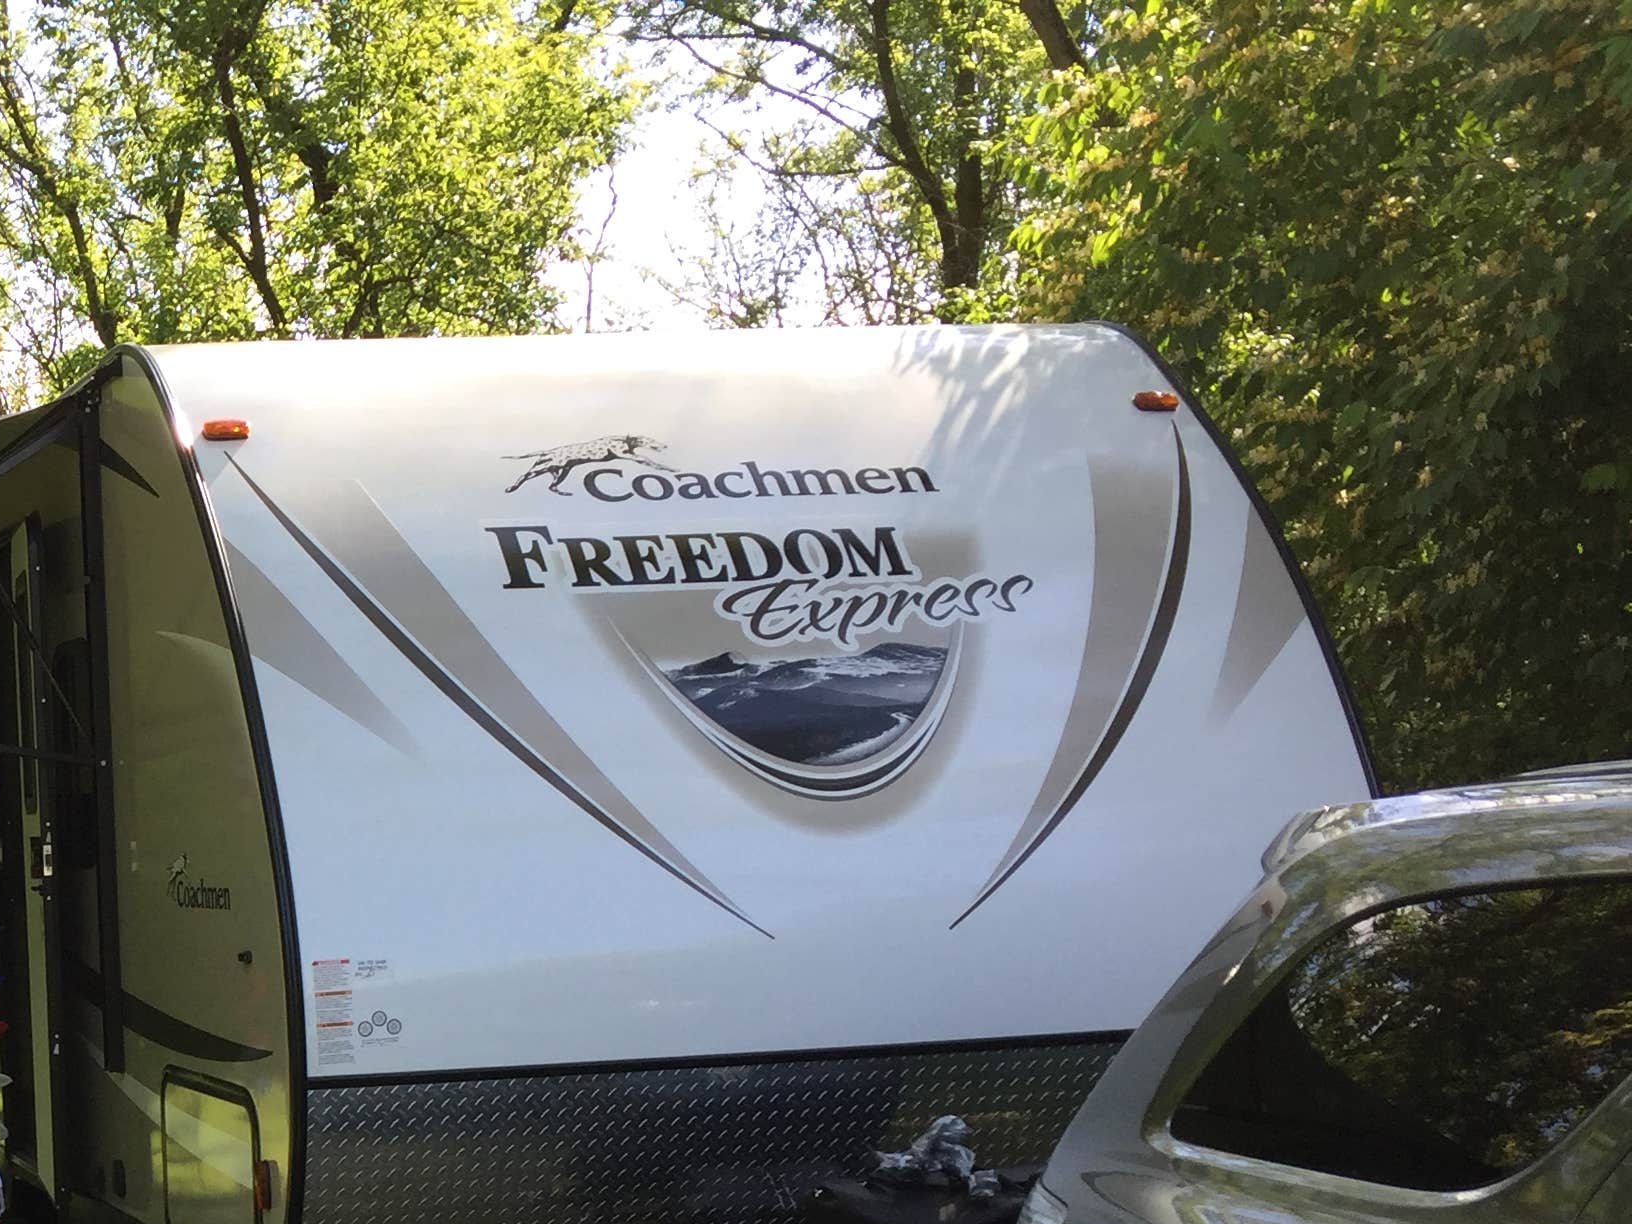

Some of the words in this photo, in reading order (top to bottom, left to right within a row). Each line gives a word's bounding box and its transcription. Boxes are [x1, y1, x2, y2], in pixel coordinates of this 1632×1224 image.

[582, 460, 940, 503] Coachmen
[484, 525, 913, 590] FREEDOM
[721, 574, 1035, 645] Express
[176, 878, 231, 911] Coachmen
